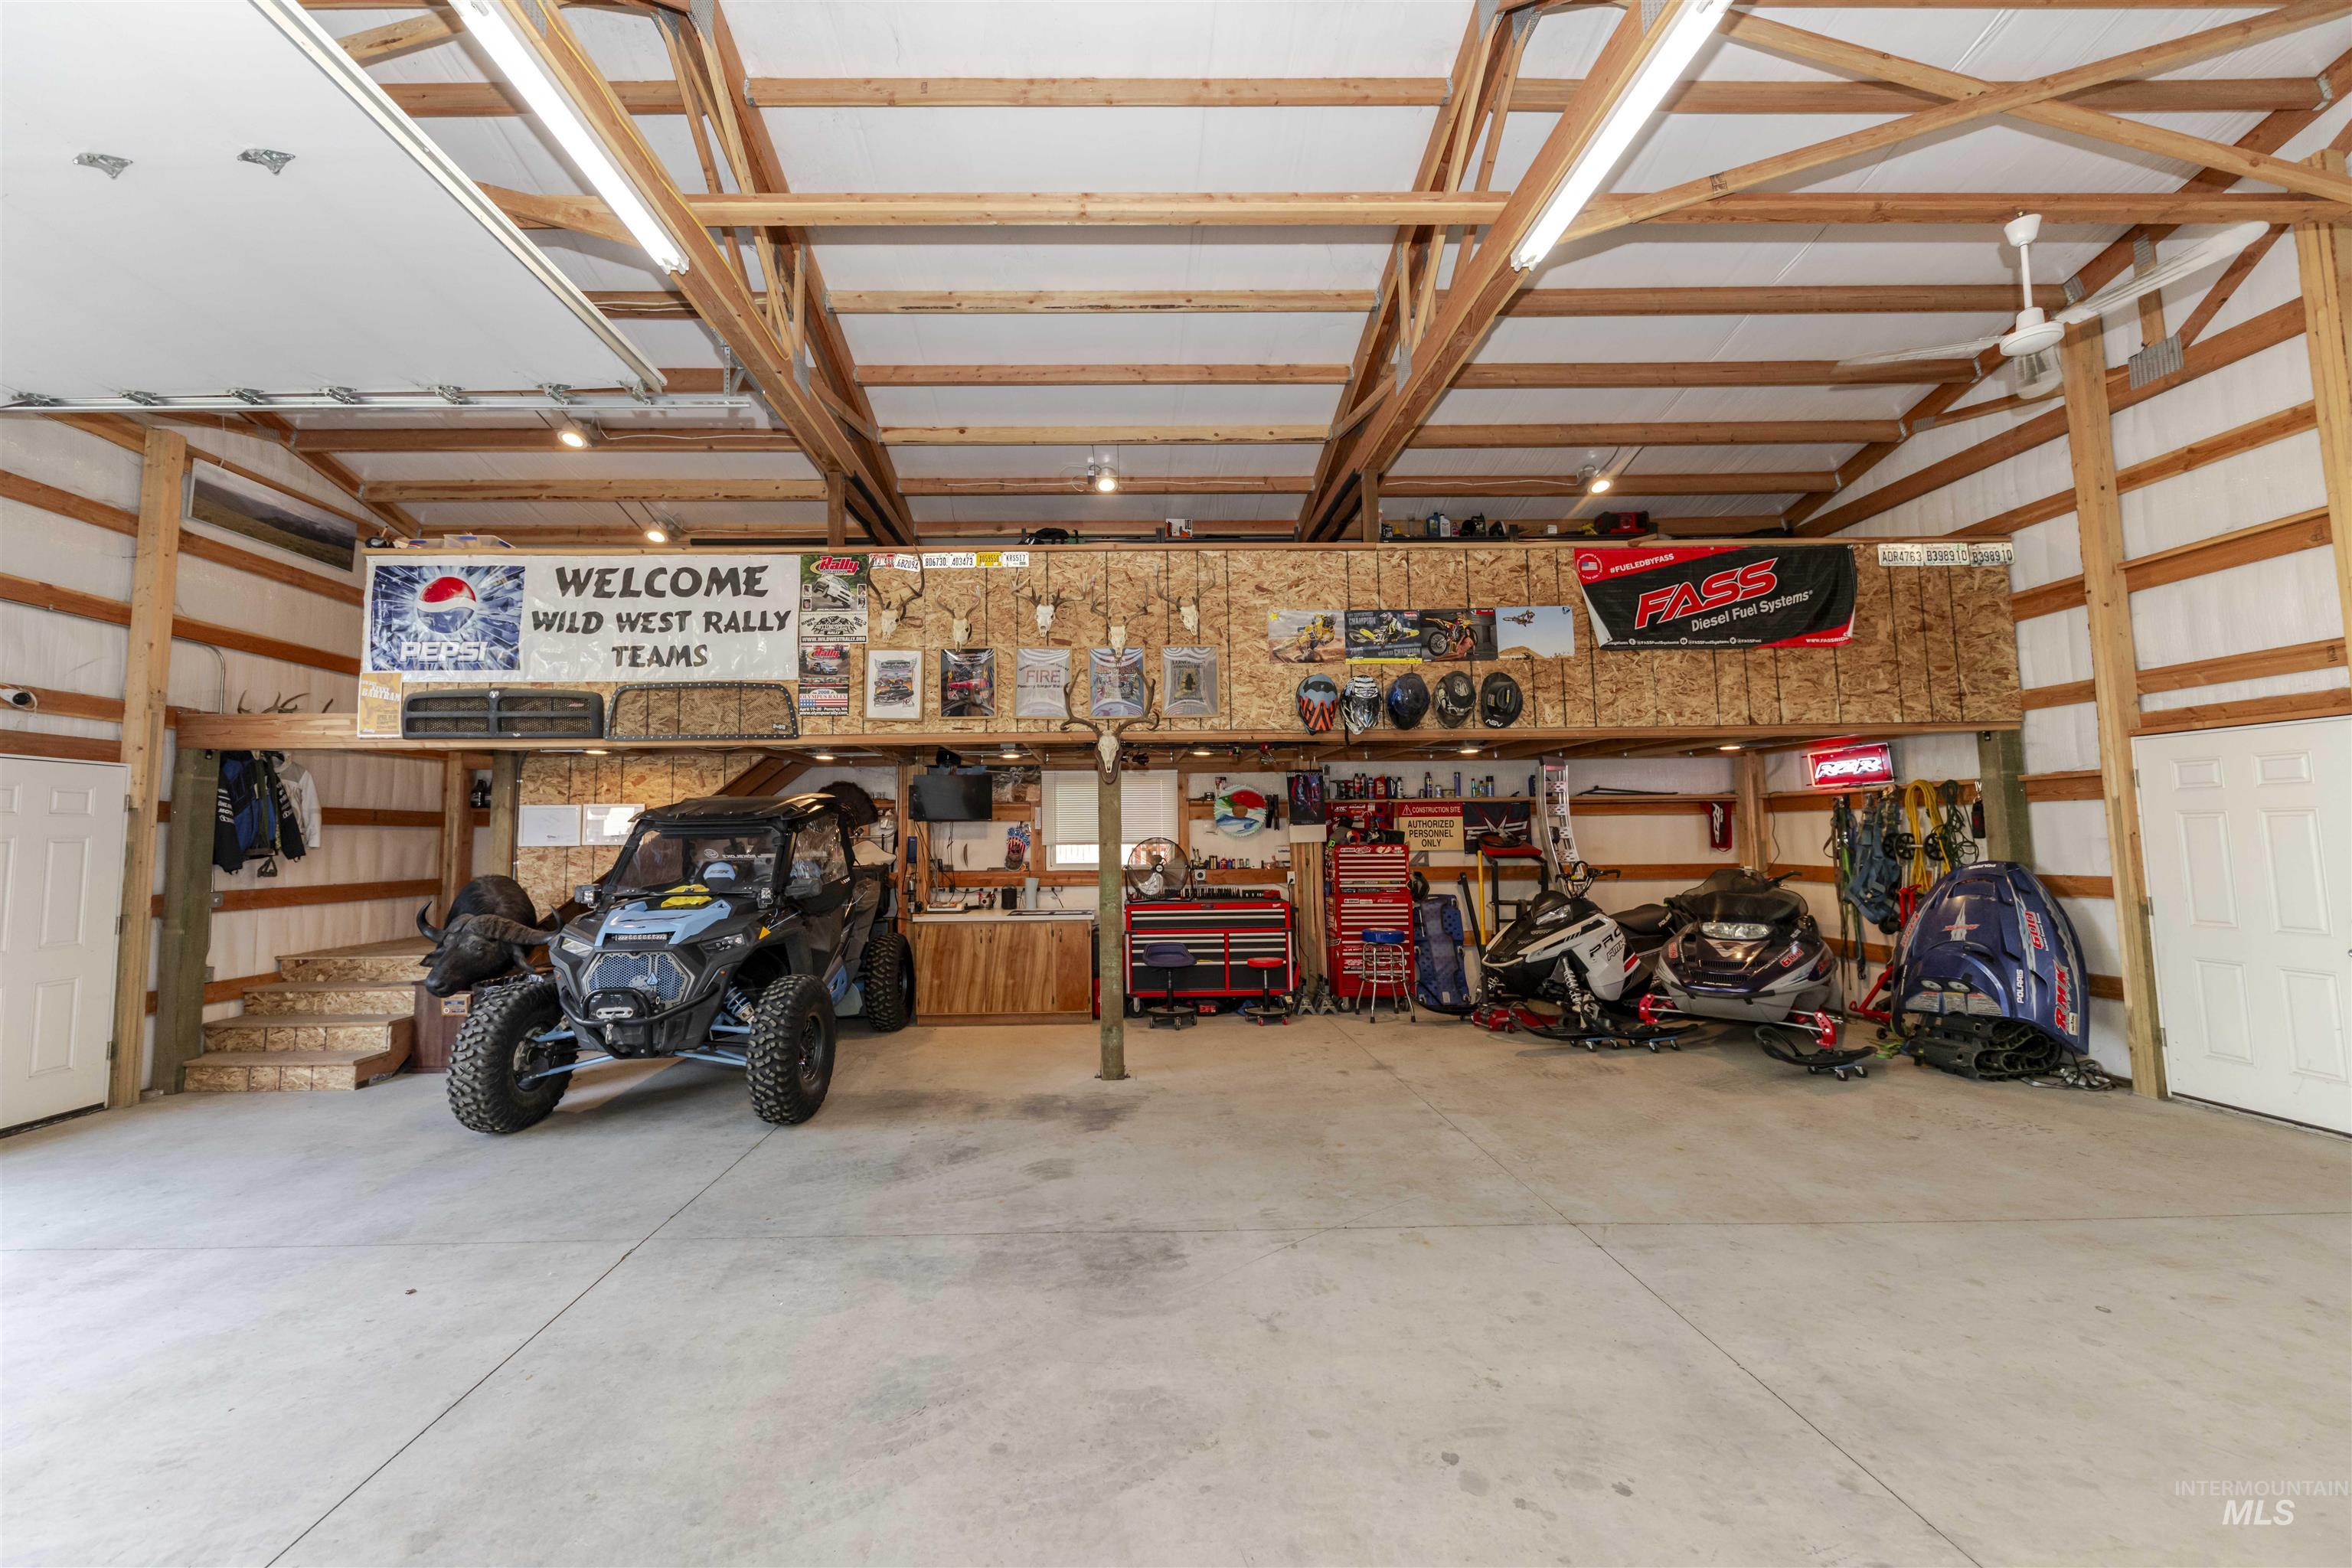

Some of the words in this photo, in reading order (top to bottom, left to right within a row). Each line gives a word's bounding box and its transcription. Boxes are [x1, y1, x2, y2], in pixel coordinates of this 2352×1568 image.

[818, 556, 859, 573] Rally
[1609, 553, 1675, 574] #FUELEDBYFASS
[555, 565, 769, 599] WELCOME
[1635, 557, 1779, 630] FASS
[531, 610, 604, 635] WILD
[616, 609, 692, 634] WEST
[702, 609, 792, 634] RALLY
[1348, 617, 1377, 626] CHAMPION
[1691, 610, 1730, 632] Diesel
[1732, 603, 1758, 621] Fuel
[400, 641, 488, 662] PEPSI
[612, 644, 707, 668] TEAMS
[813, 646, 841, 658] Rally
[1026, 670, 1061, 683] FIRE
[1407, 820, 1455, 828] AUTHORIZED
[1409, 829, 1453, 838] PERSONNEL
[2024, 911, 2044, 949] 600
[2017, 969, 2025, 1004] POLARIS
[2052, 955, 2069, 1035] RMK
